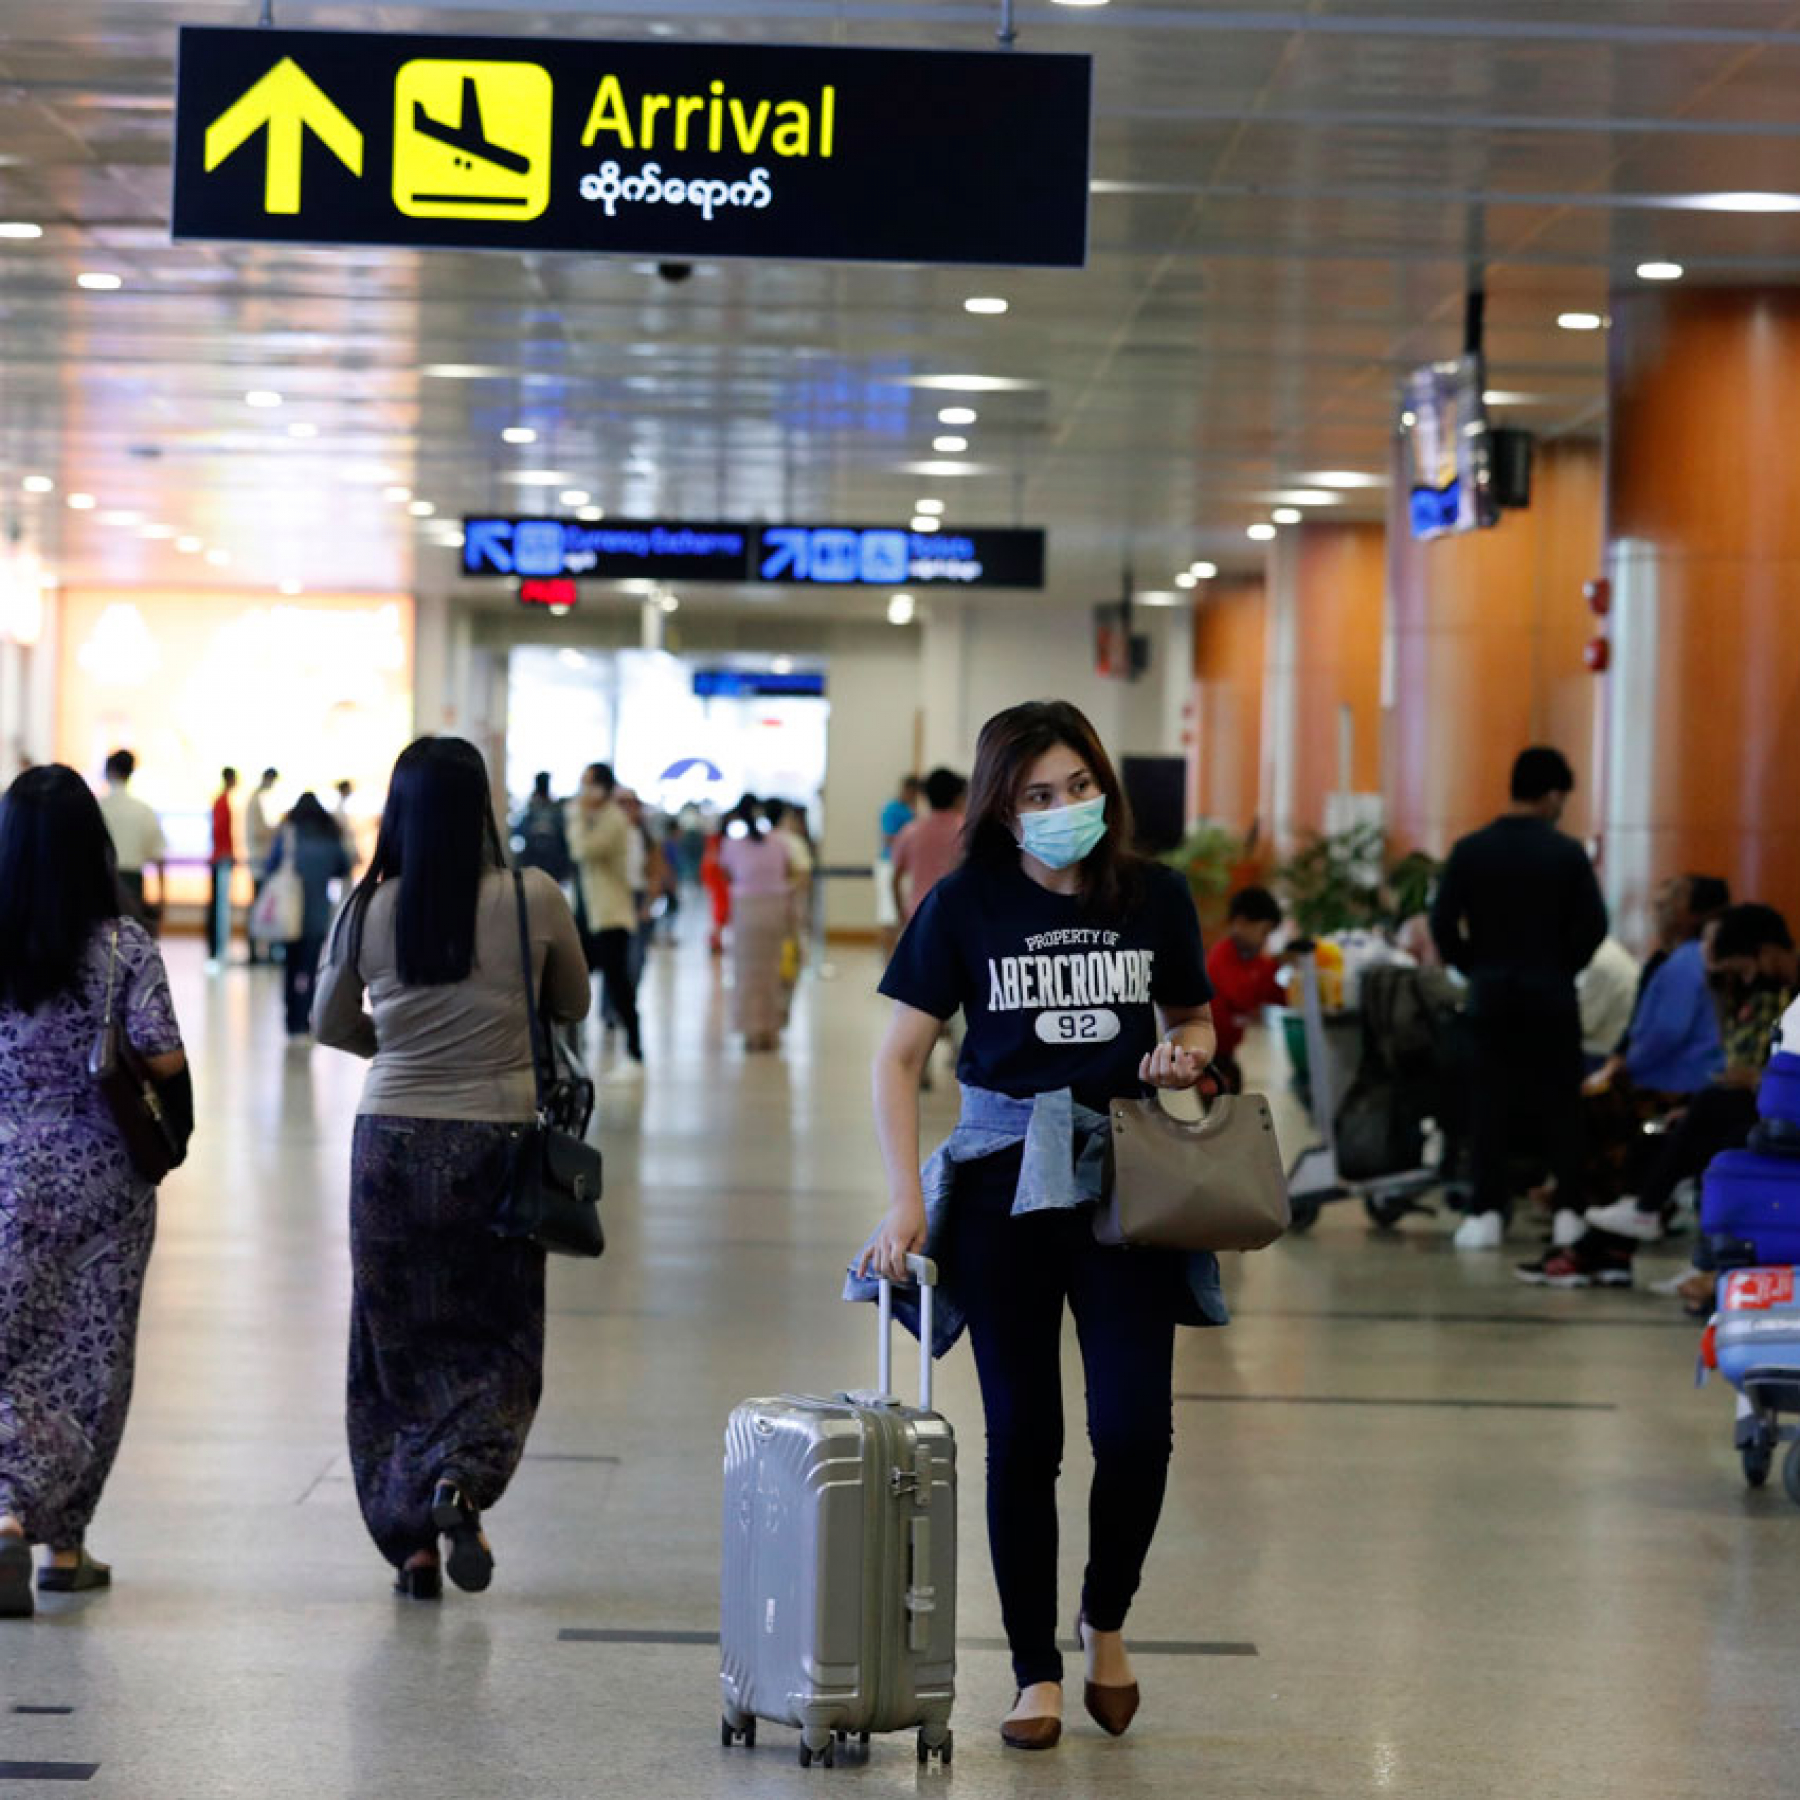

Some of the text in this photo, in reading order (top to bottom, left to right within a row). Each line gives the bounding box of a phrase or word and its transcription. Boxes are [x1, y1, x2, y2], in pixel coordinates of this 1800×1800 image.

[581, 74, 834, 157] Arrival
[580, 161, 771, 220] ဆိုက်ရောက်
[1024, 929, 1120, 951] PROPERTY OF
[1058, 1015, 1098, 1039] 92
